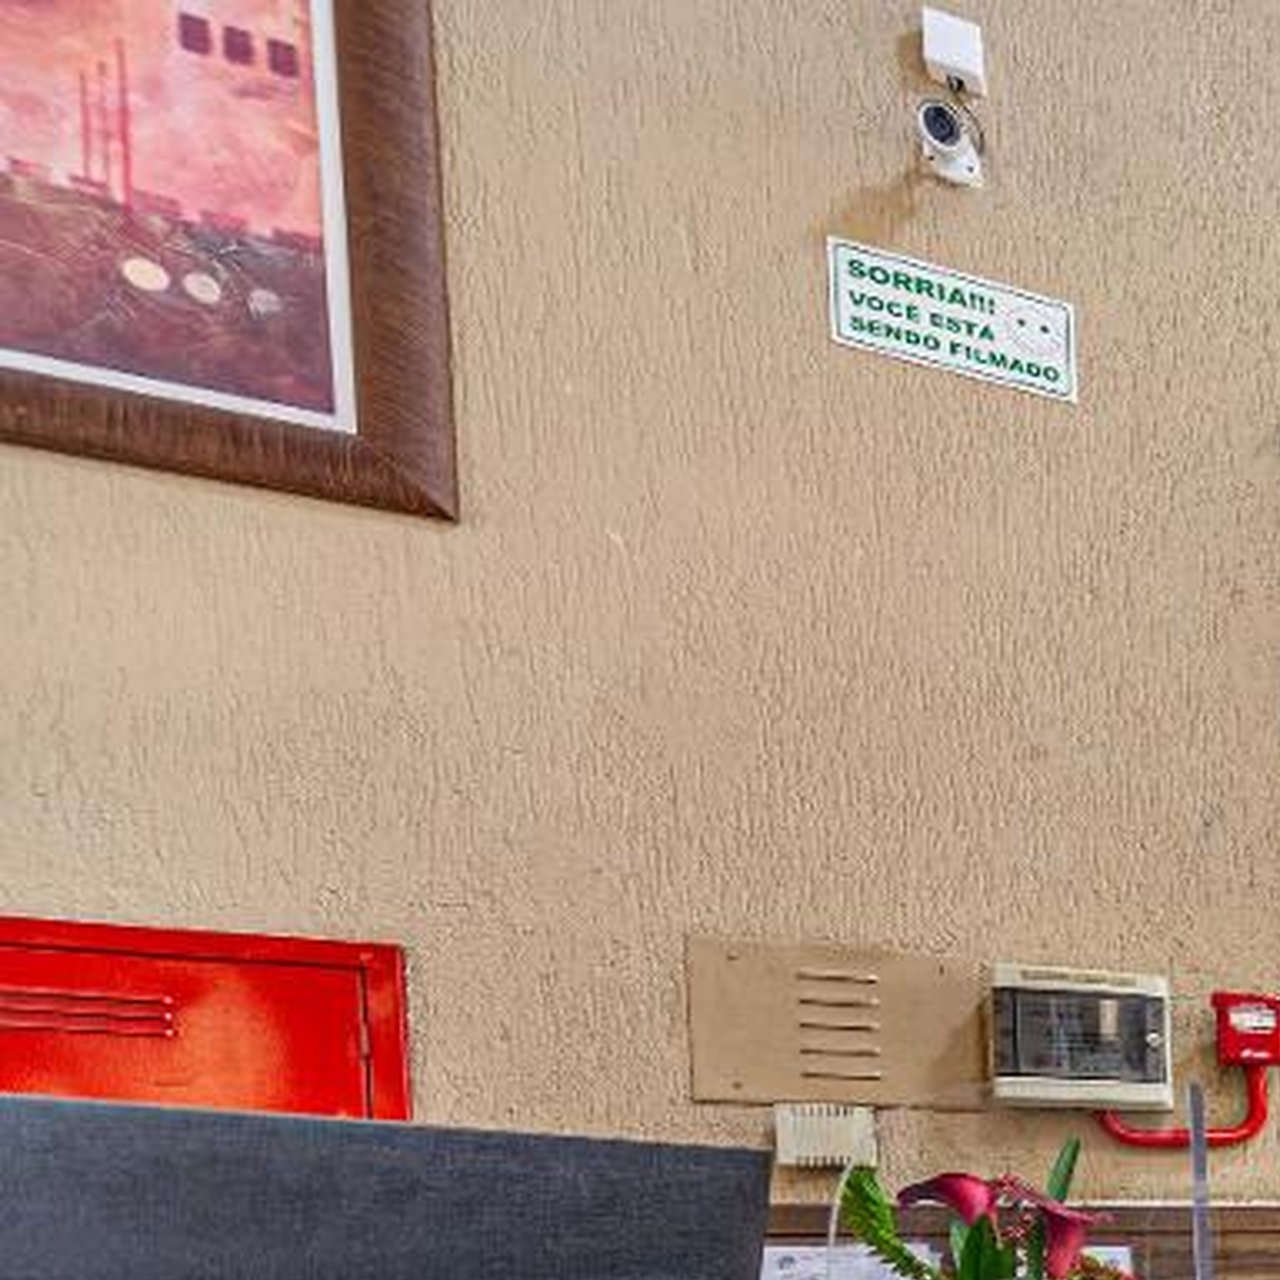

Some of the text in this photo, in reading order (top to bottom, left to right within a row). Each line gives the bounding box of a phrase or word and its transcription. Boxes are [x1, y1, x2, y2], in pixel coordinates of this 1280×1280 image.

[848, 258, 996, 315] SORRIA!!!
[849, 315, 1061, 383] SENDO FILMADO
